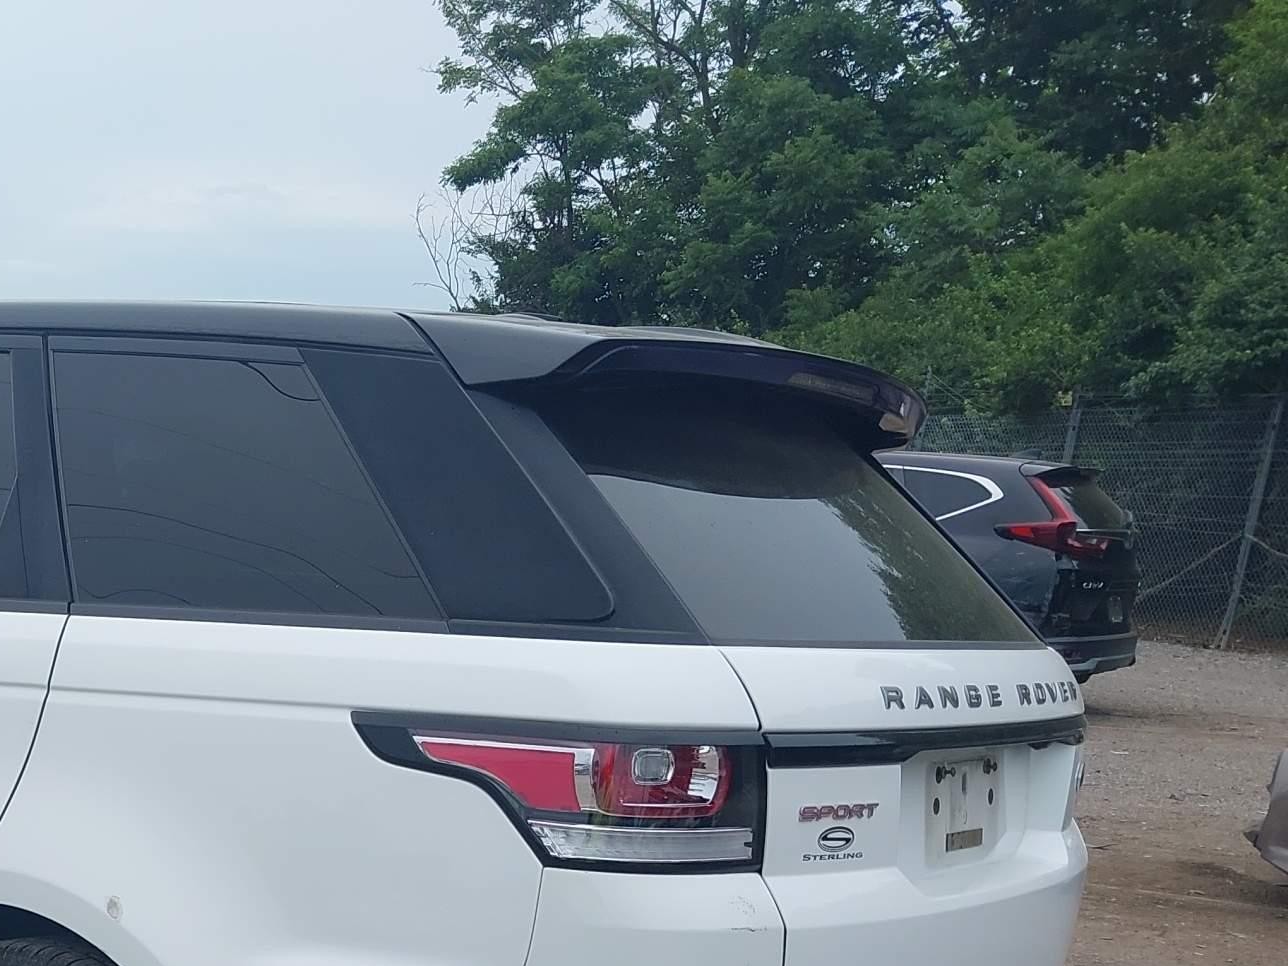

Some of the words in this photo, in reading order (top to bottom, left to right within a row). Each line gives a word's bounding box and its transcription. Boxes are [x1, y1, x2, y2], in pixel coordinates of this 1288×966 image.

[880, 684, 1003, 710] RANGE
[798, 803, 879, 822] SPORT
[802, 851, 863, 861] STERLING
